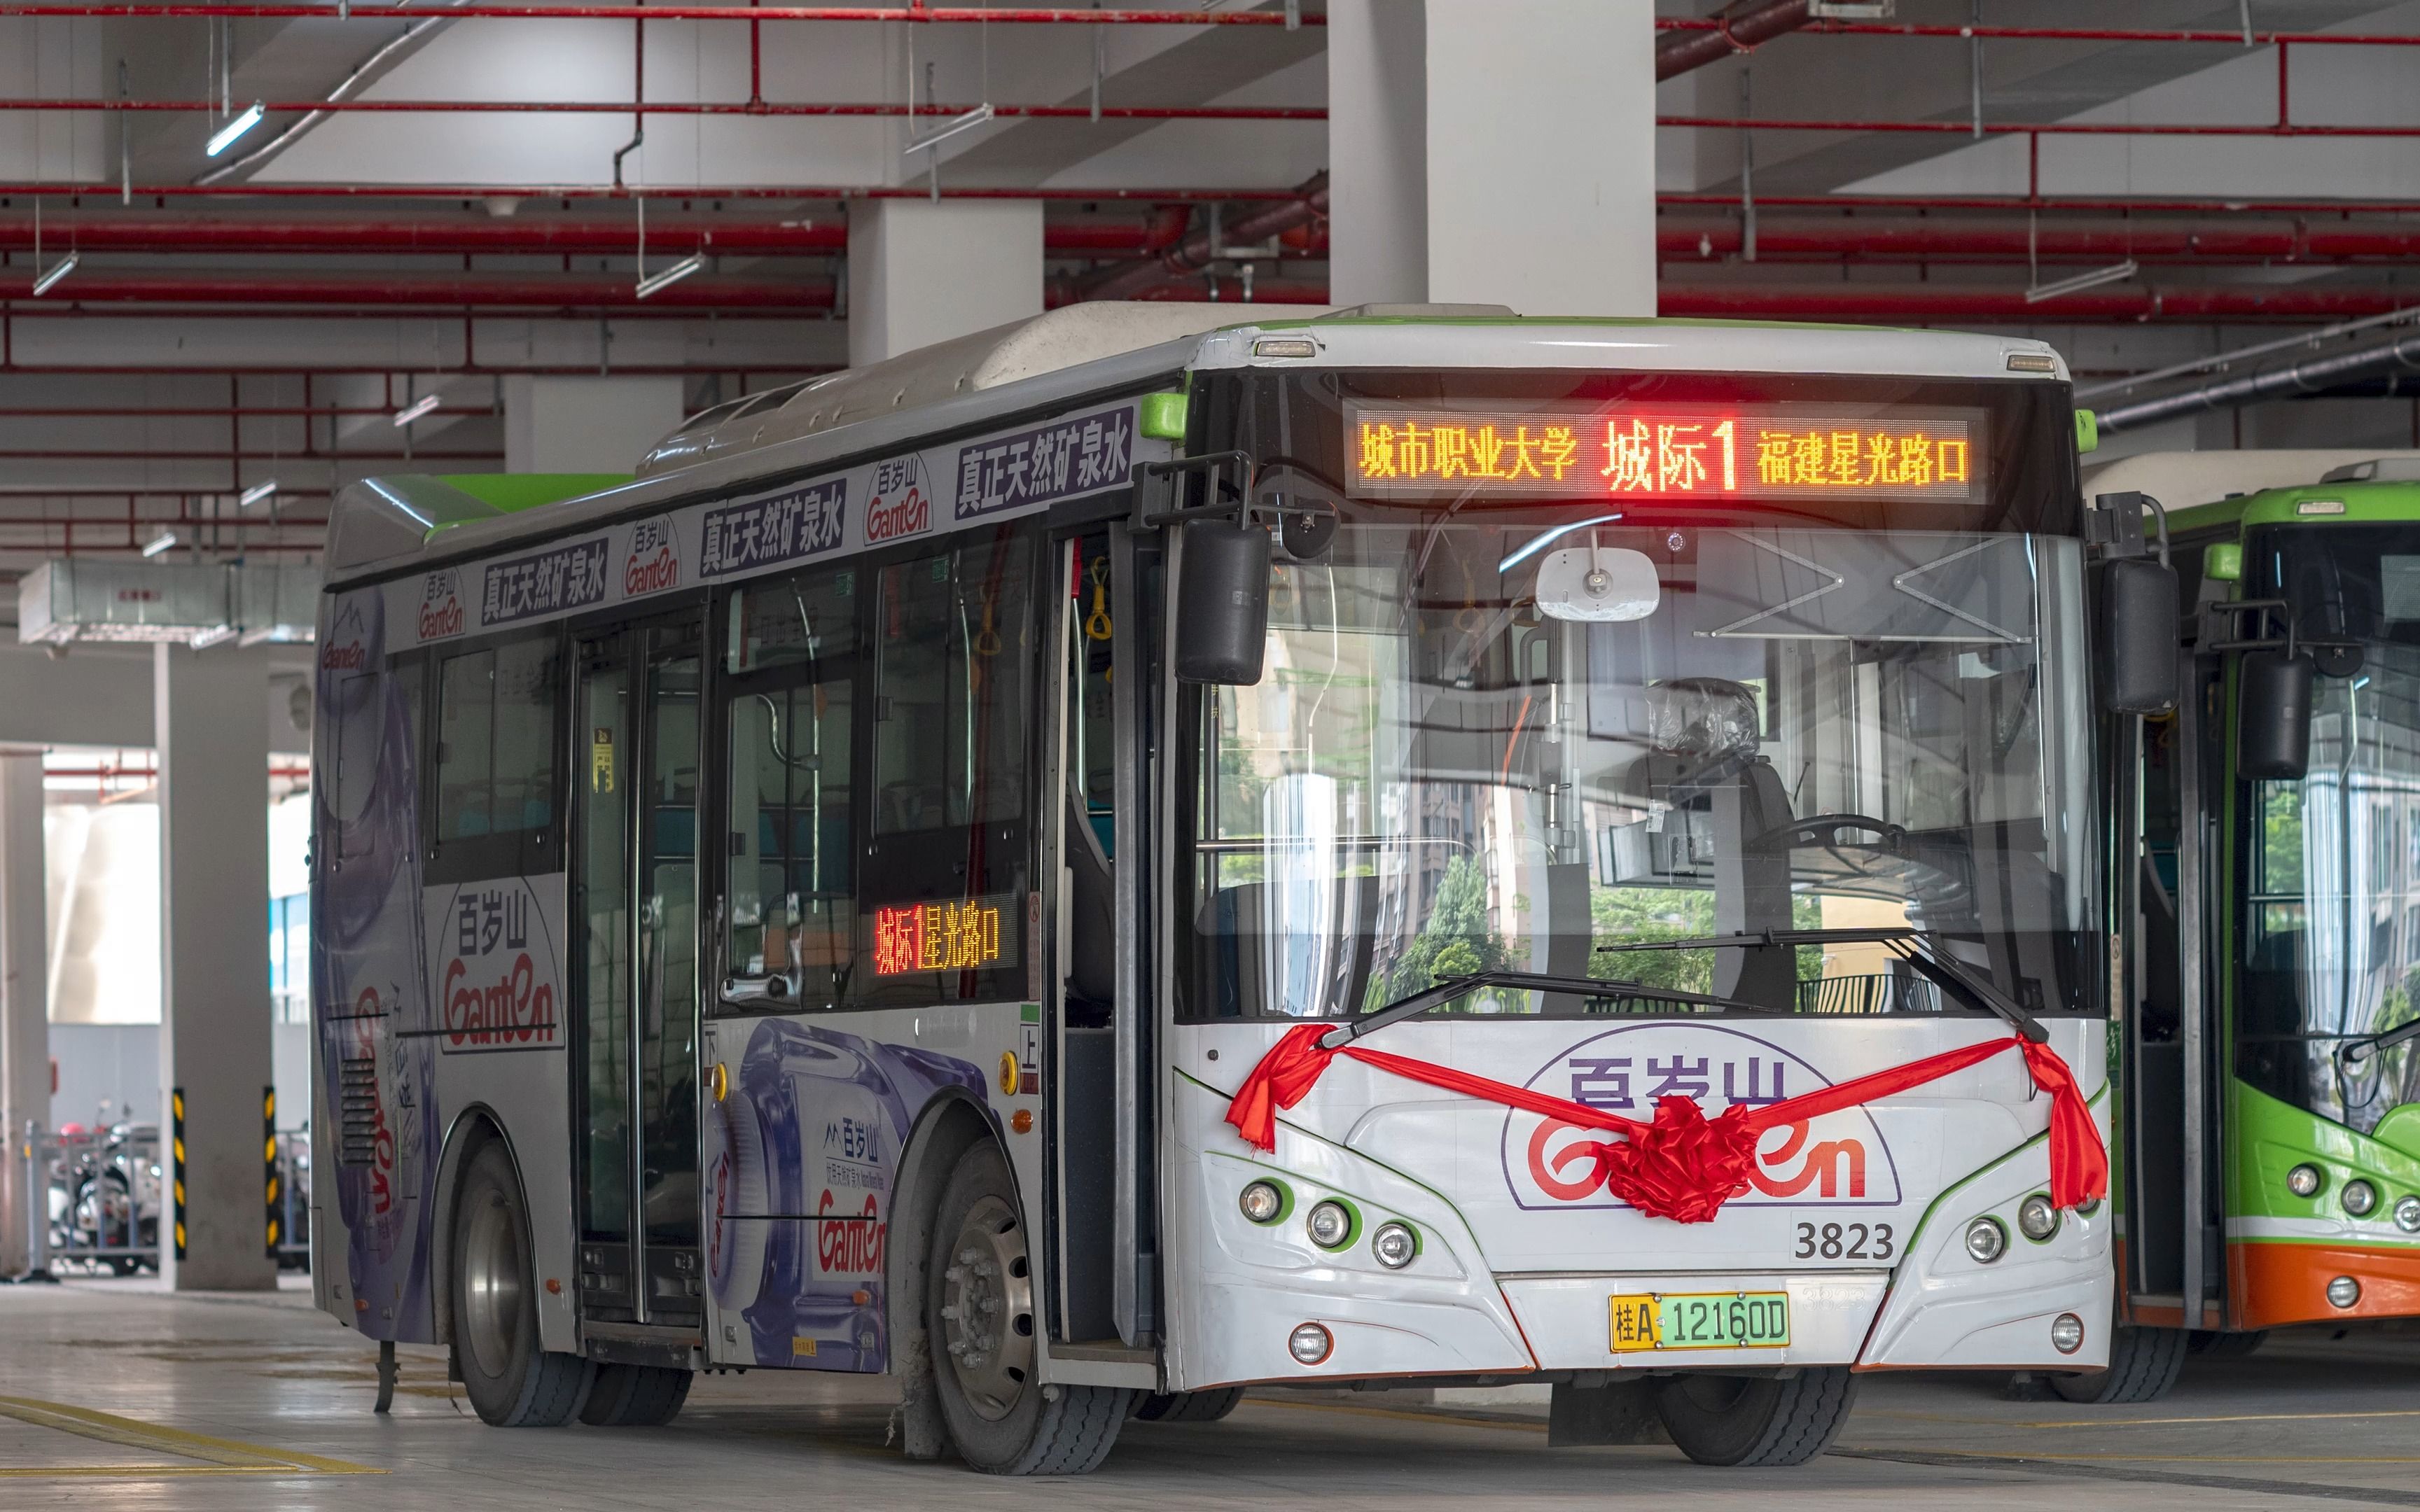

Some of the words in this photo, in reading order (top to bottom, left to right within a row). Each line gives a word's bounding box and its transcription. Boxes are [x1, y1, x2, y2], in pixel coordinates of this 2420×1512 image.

[878, 458, 917, 495] 百岁山
[959, 413, 1129, 516] 真正天然矿泉水
[1359, 422, 1577, 481] 城市职业大学
[1602, 419, 1736, 493] 城际1
[1758, 430, 1967, 486] 福建星光路口
[635, 520, 669, 553] 百岁山
[702, 484, 842, 574] 真正天然矿泉水
[426, 571, 456, 601] 百岁山
[484, 543, 605, 623] 真正天然矿泉水
[459, 889, 527, 956] 百岁山
[704, 1030, 716, 1065] 下
[1022, 1030, 1036, 1069] 上
[1569, 1056, 1788, 1110] 百岁山
[842, 1117, 878, 1163] 百岁山
[1528, 1117, 1865, 1200] Gen
[1795, 1222, 1893, 1260] 3823
[1615, 1303, 1654, 1343] 桂A
[1673, 1301, 1785, 1341] 12160D
